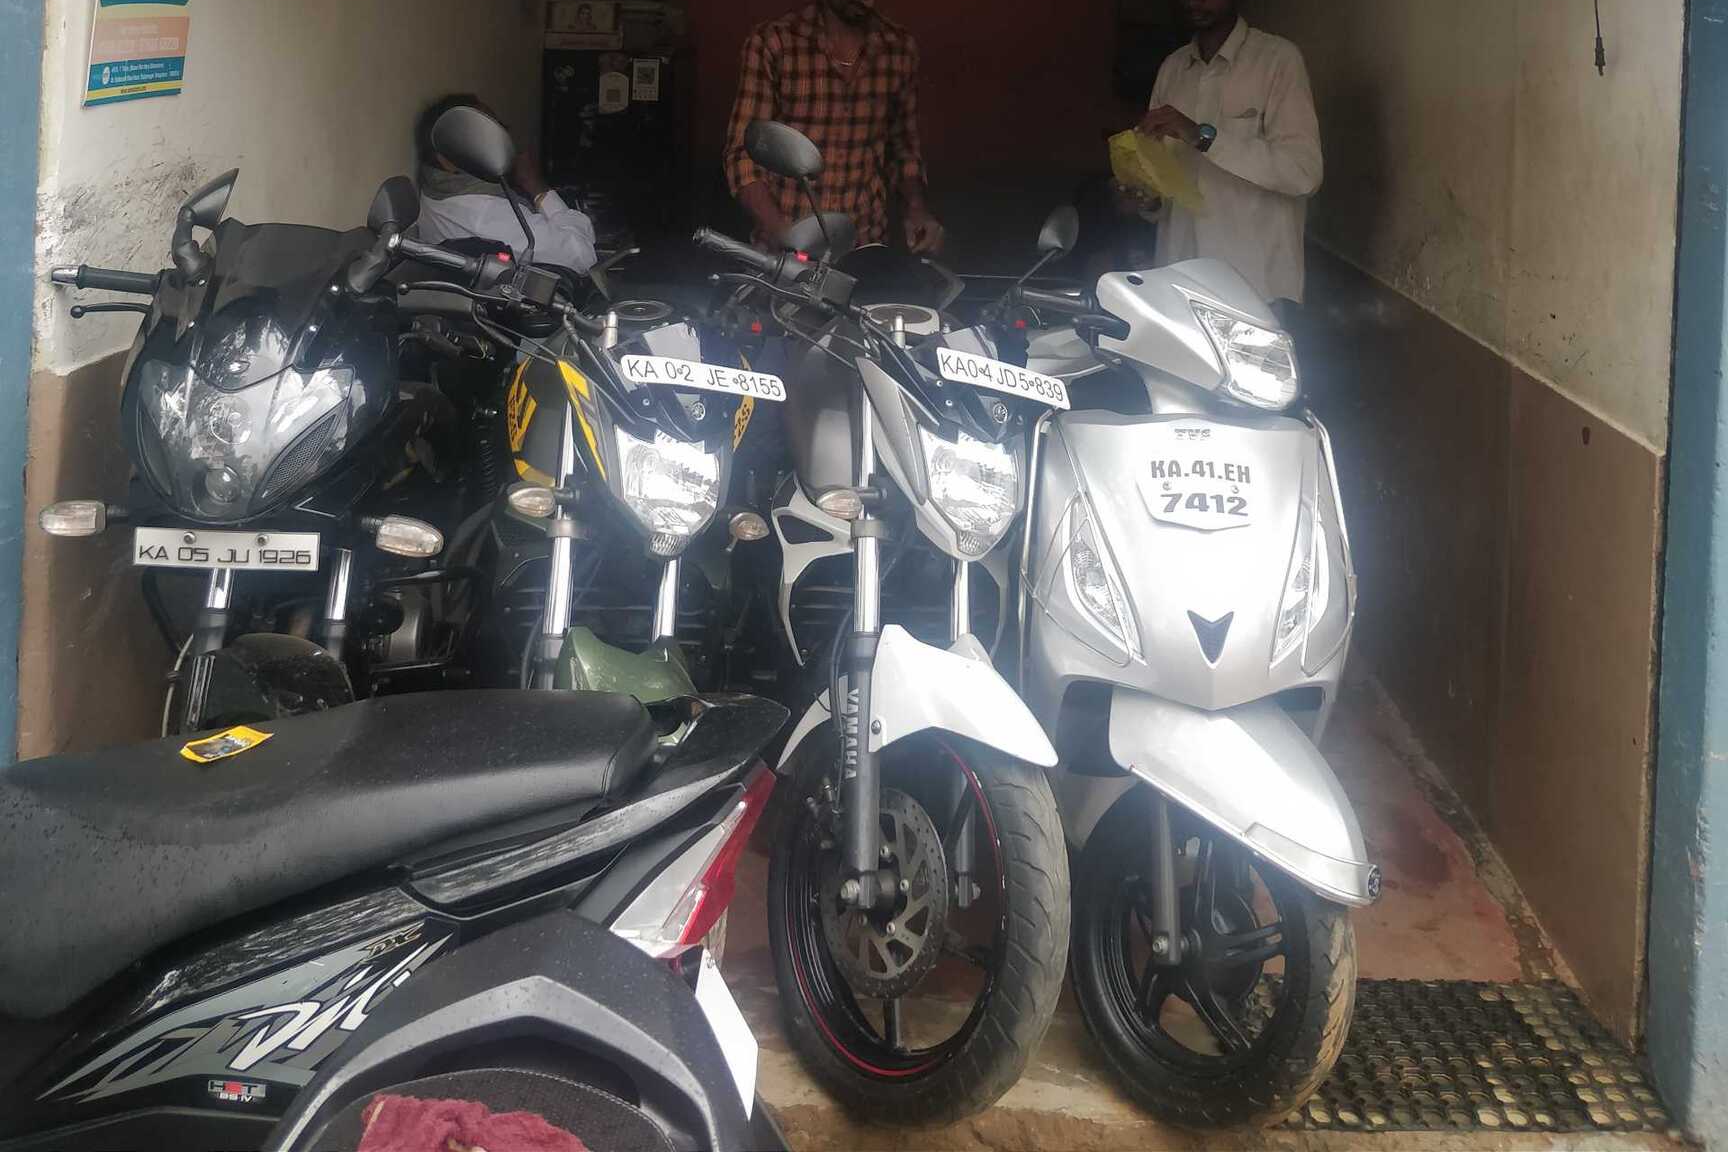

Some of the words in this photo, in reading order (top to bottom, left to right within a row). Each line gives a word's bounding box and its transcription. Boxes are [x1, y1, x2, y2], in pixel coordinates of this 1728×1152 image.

[627, 359, 660, 379] KA
[664, 360, 694, 382] 02
[706, 369, 730, 388] JE
[738, 373, 781, 397] 8155
[1160, 493, 1249, 517] 7412
[138, 545, 169, 560] KA
[178, 547, 210, 562] 05
[217, 548, 250, 564] JU
[259, 549, 311, 565] 1926
[844, 688, 860, 780] YAMAHA
